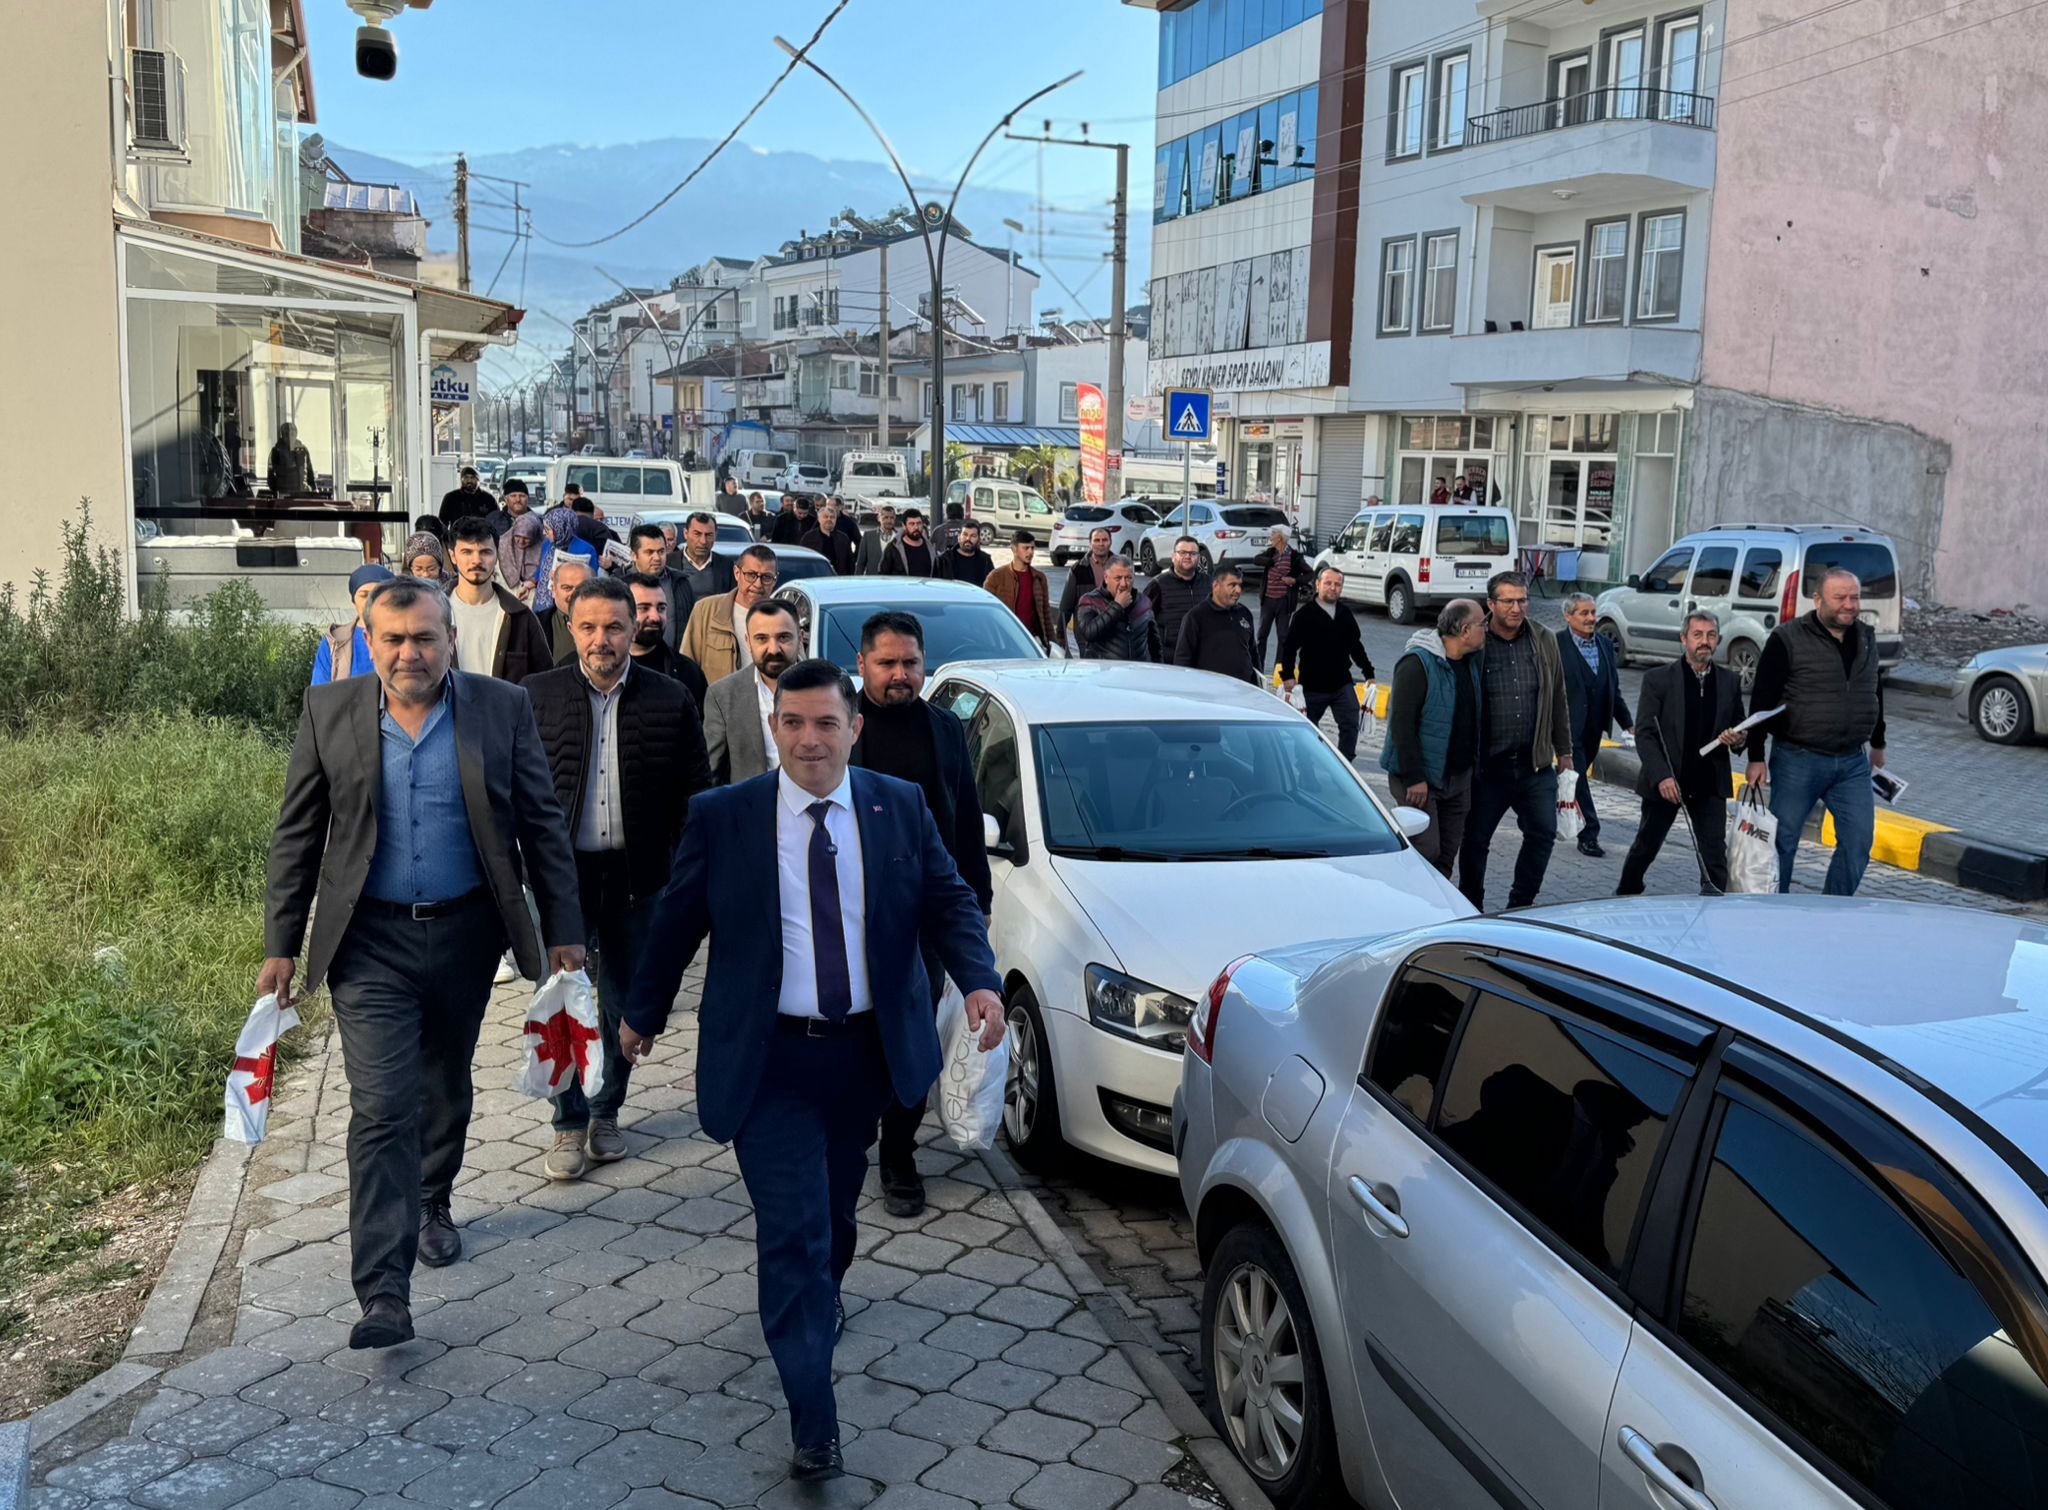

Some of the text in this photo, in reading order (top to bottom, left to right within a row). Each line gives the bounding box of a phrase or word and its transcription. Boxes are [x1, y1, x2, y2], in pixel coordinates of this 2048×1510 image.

[1202, 364, 1226, 388] KEMER
[1226, 363, 1249, 388] SPOR
[1249, 360, 1285, 387] SALONU
